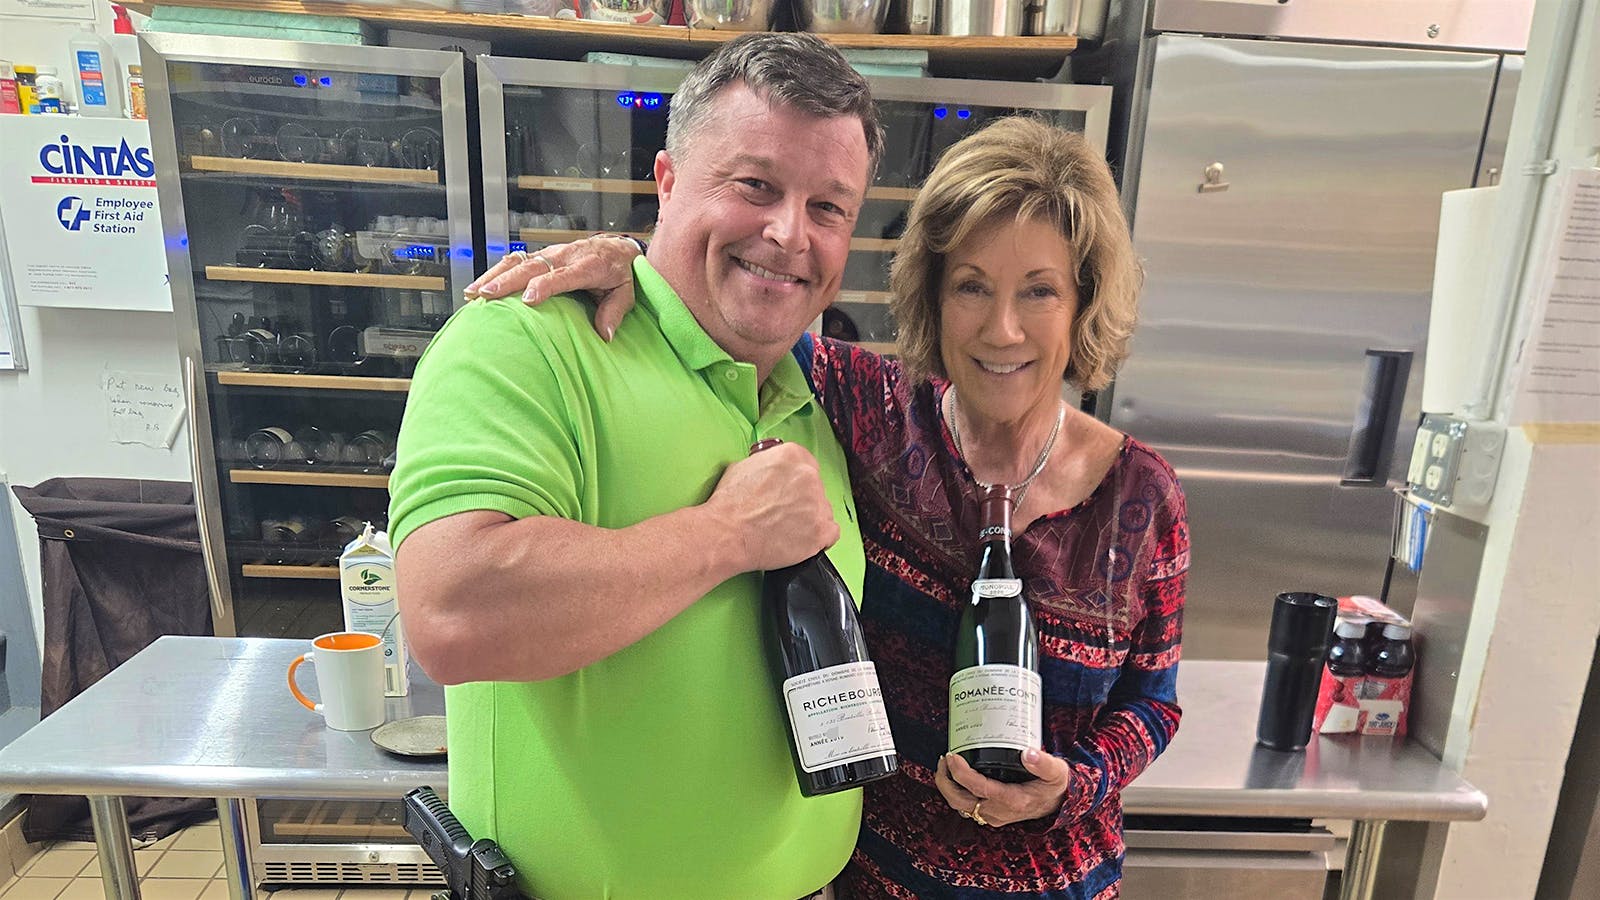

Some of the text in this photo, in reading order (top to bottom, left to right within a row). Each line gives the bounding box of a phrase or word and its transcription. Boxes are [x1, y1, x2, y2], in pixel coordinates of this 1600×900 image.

[40, 134, 155, 178] CINTAS
[117, 179, 153, 187] SAFETY
[95, 197, 154, 210] Employee
[94, 210, 144, 221] First Aid
[93, 223, 136, 234] Station
[107, 376, 126, 390] Put
[954, 685, 1037, 705] ROMANÉE-CONTI
